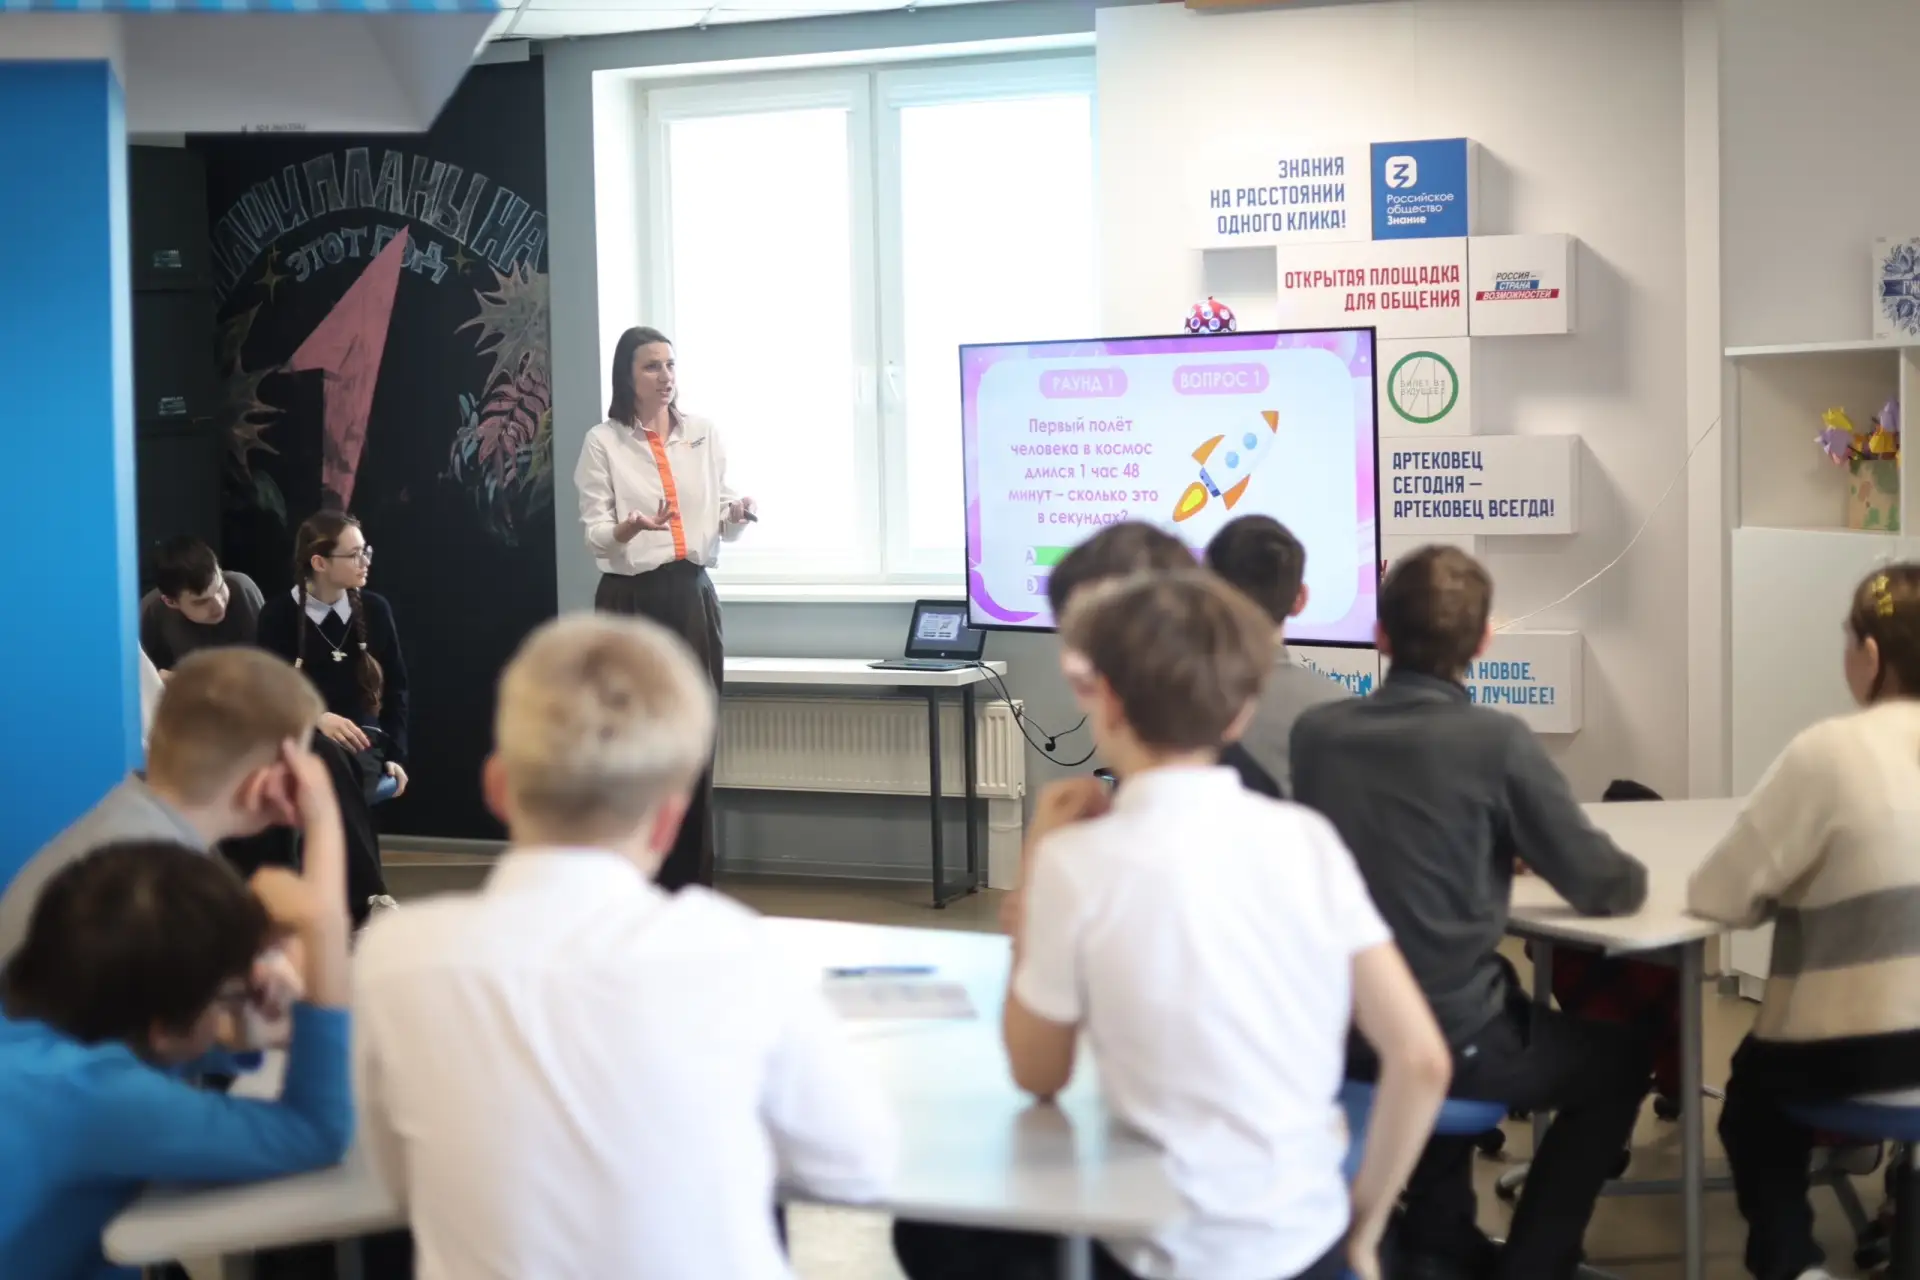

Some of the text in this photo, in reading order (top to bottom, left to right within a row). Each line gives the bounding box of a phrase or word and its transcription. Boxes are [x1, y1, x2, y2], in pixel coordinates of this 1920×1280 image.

[1278, 156, 1345, 179] ЗНАНИЯ
[302, 147, 490, 245] ПЛАНЫ
[1210, 183, 1345, 208] НА РАССТОЯНИИ
[1386, 192, 1455, 204] Российское
[1386, 204, 1443, 214] общество
[1217, 209, 1346, 235] ОДНОГО КЛИКА!
[1387, 215, 1427, 226] Знание
[285, 226, 368, 282] ЭТОТ
[1285, 264, 1460, 288] ОТКРЫТАЯ ПЛОЩАДКА
[1496, 271, 1530, 280] РОССИЯ
[1483, 289, 1552, 300] ВОЗМОЖНОСТЕЙ
[1500, 281, 1531, 290] СТРАНА
[1344, 289, 1460, 312] ДЛЯ ОБЩЕНИЯ
[1053, 375, 1114, 392] РАУНД 1
[1180, 371, 1261, 389] ВОПРОС 1
[1029, 416, 1133, 436] Первый полёт
[1010, 443, 1153, 456] человека в космос
[1024, 462, 1140, 479] длился 1 час 48
[1393, 451, 1483, 471] АРТЕКОВЕЦ
[1393, 475, 1464, 495] СЕГОДНЯ
[1008, 489, 1052, 504] минут
[1067, 489, 1128, 502] сколько
[1132, 489, 1159, 502] это
[1037, 509, 1129, 527] в секундах?
[1394, 499, 1554, 520] АРТЕКОВЕЦ ВСЕГДА!
[1479, 662, 1535, 681] НОВОЕ,
[1482, 686, 1554, 705] ЛУЧШЕЕ!
